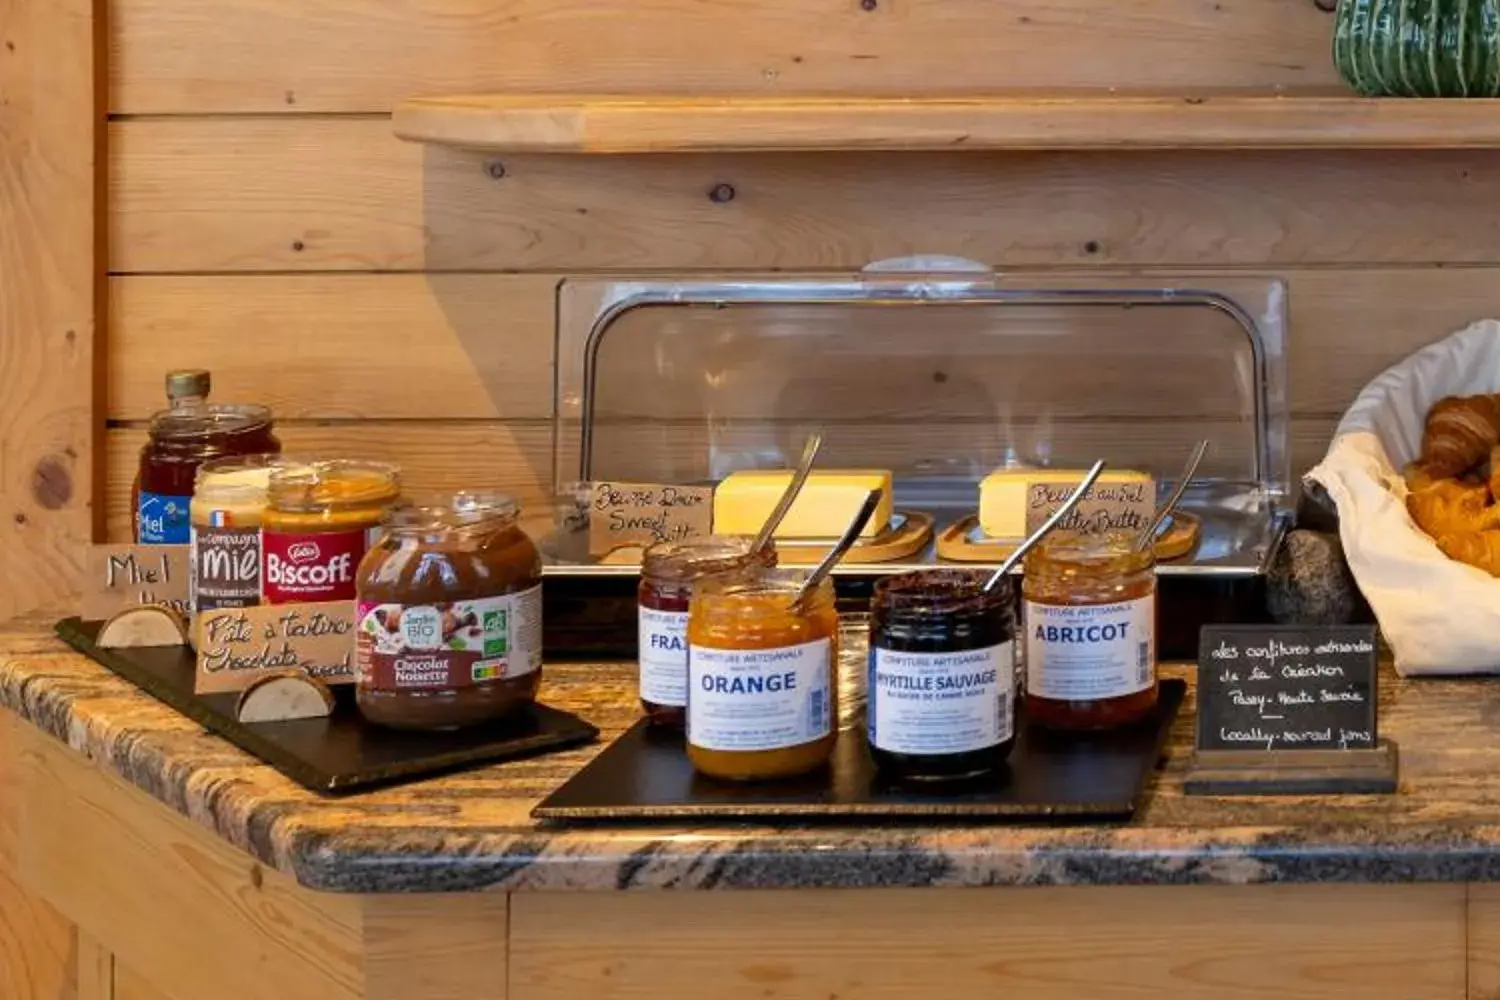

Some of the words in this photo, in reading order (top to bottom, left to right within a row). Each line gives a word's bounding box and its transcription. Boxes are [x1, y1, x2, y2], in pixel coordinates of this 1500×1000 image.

[106, 553, 170, 587] Miel
[267, 552, 351, 585] Biscoff
[1035, 621, 1131, 643] ABRICOT
[702, 672, 798, 694] ORANGE
[937, 669, 997, 690] SAUVAGE
